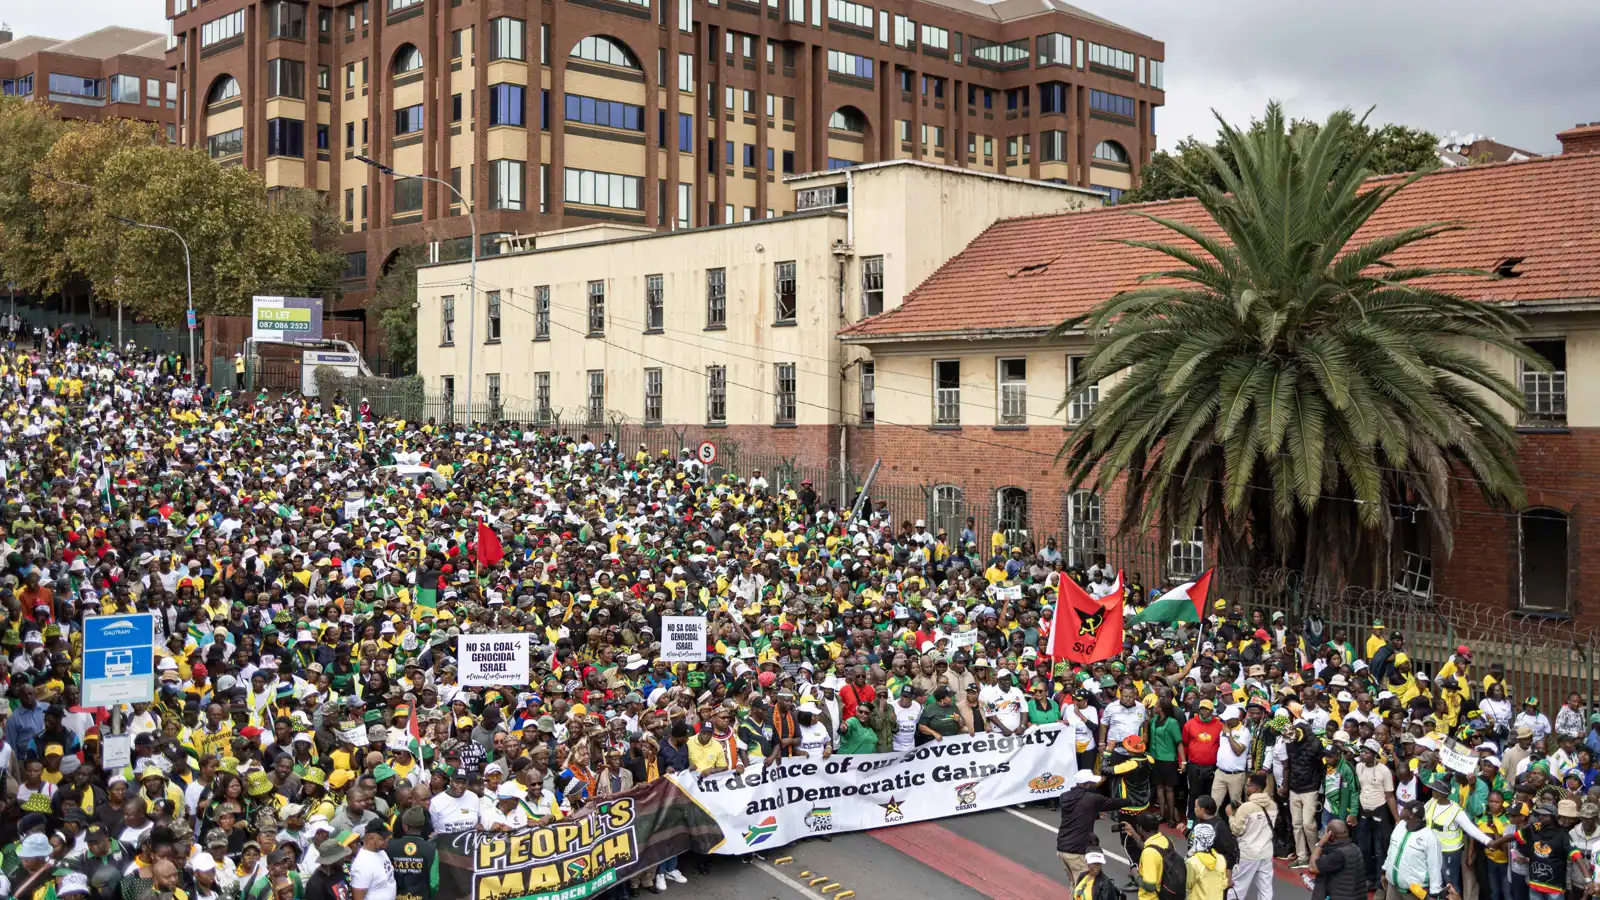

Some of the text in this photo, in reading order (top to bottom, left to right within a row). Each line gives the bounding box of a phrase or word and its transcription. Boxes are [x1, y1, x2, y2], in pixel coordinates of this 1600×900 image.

[260, 310, 290, 320] TO LET
[703, 446, 711, 458] S
[666, 623, 675, 631] NO
[676, 623, 683, 632] SA
[685, 623, 697, 631] COAL
[670, 632, 699, 641] GENOCIDAL
[466, 642, 477, 652] NO
[480, 642, 491, 652] SA
[493, 642, 514, 651] COAL
[675, 642, 693, 650] ISRAEL
[471, 652, 516, 662] GENOCIDAL
[480, 662, 507, 672] ISRAEL
[725, 763, 817, 791] defence
[825, 757, 853, 775] of
[857, 757, 898, 772] our
[899, 729, 1061, 763] sovereignty
[746, 760, 1011, 815] and Democratic Gains
[1029, 785, 1065, 794] SANCO
[955, 803, 977, 811] COSATU
[884, 815, 904, 823] SACP
[814, 824, 833, 832] ANC
[477, 832, 632, 900] MARCH
